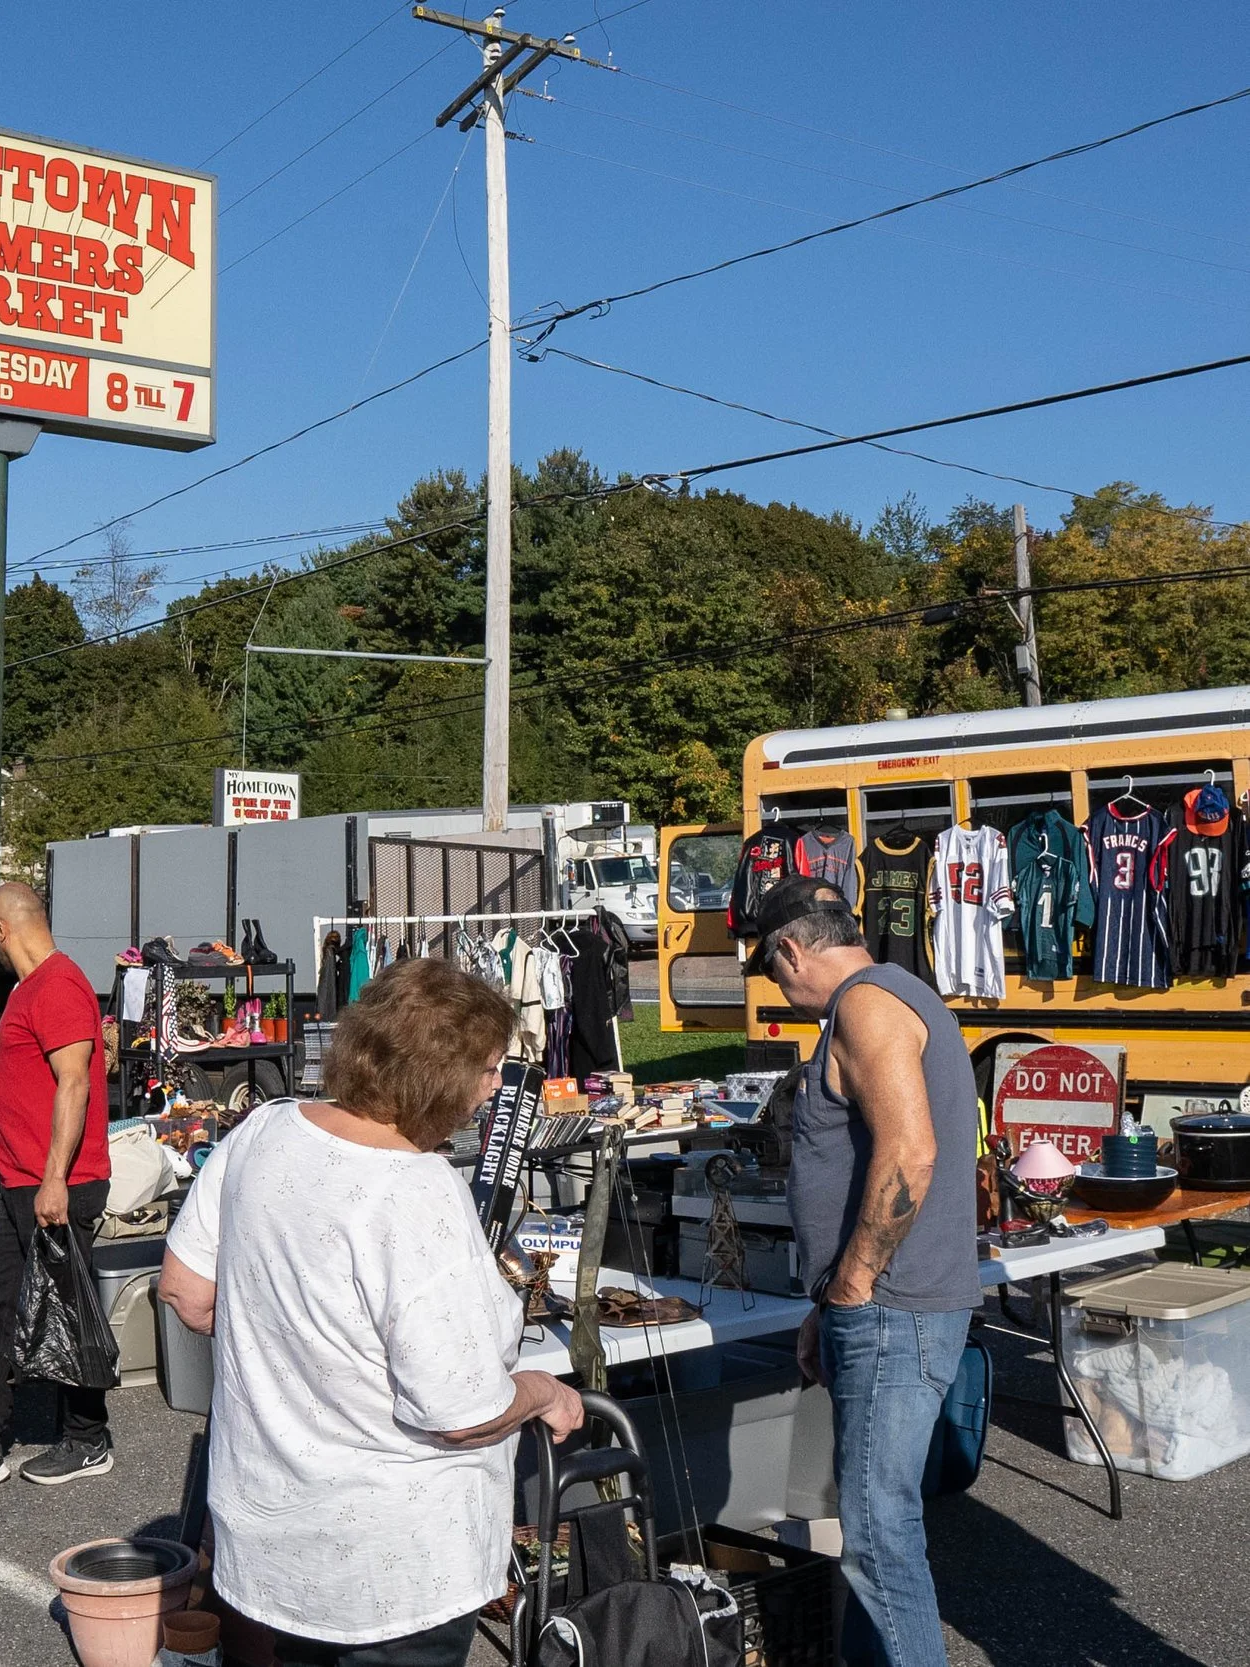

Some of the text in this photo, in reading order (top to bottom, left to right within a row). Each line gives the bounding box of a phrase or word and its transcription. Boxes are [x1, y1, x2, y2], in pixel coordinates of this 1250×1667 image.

[106, 372, 195, 421] 8 TILL 7
[878, 756, 940, 770] EMERGENCY EXIT
[227, 780, 296, 800] HOMETOWN
[232, 797, 291, 810] HME OF THE
[270, 810, 289, 820] BAR
[872, 870, 919, 888] JAMES
[947, 863, 984, 906] 52
[1113, 852, 1135, 889] 3
[1037, 892, 1053, 928] 1
[1016, 1071, 1104, 1094] DO NOT
[479, 1085, 518, 1185] BLACKLIGHT
[502, 1147, 522, 1189] NOIRE
